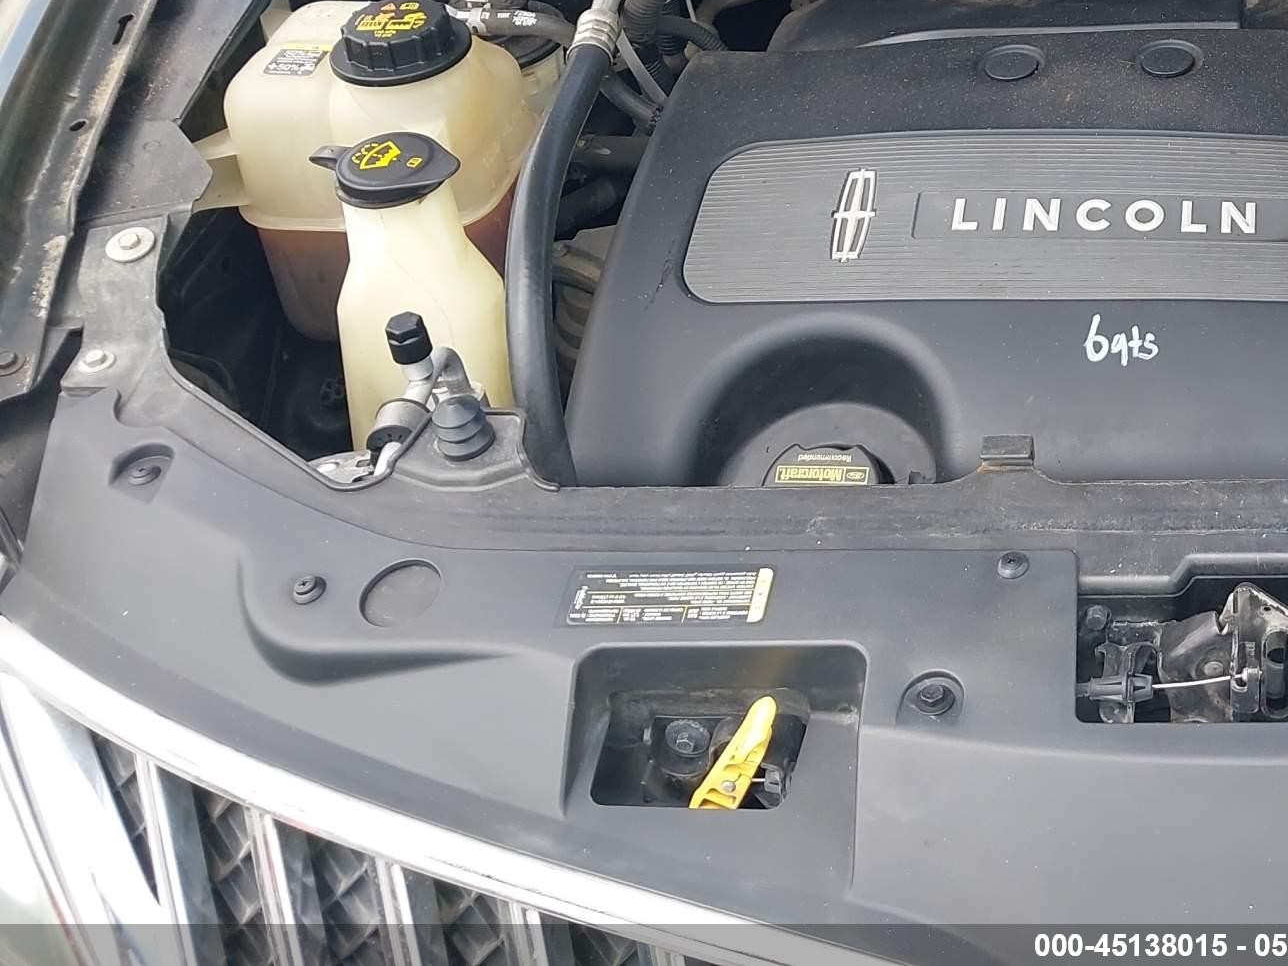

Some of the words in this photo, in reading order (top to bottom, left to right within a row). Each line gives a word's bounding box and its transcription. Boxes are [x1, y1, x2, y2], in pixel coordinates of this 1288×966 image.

[951, 198, 1257, 234] LINCOLN
[797, 454, 852, 462] Recommended
[780, 468, 843, 481] Motorcraft
